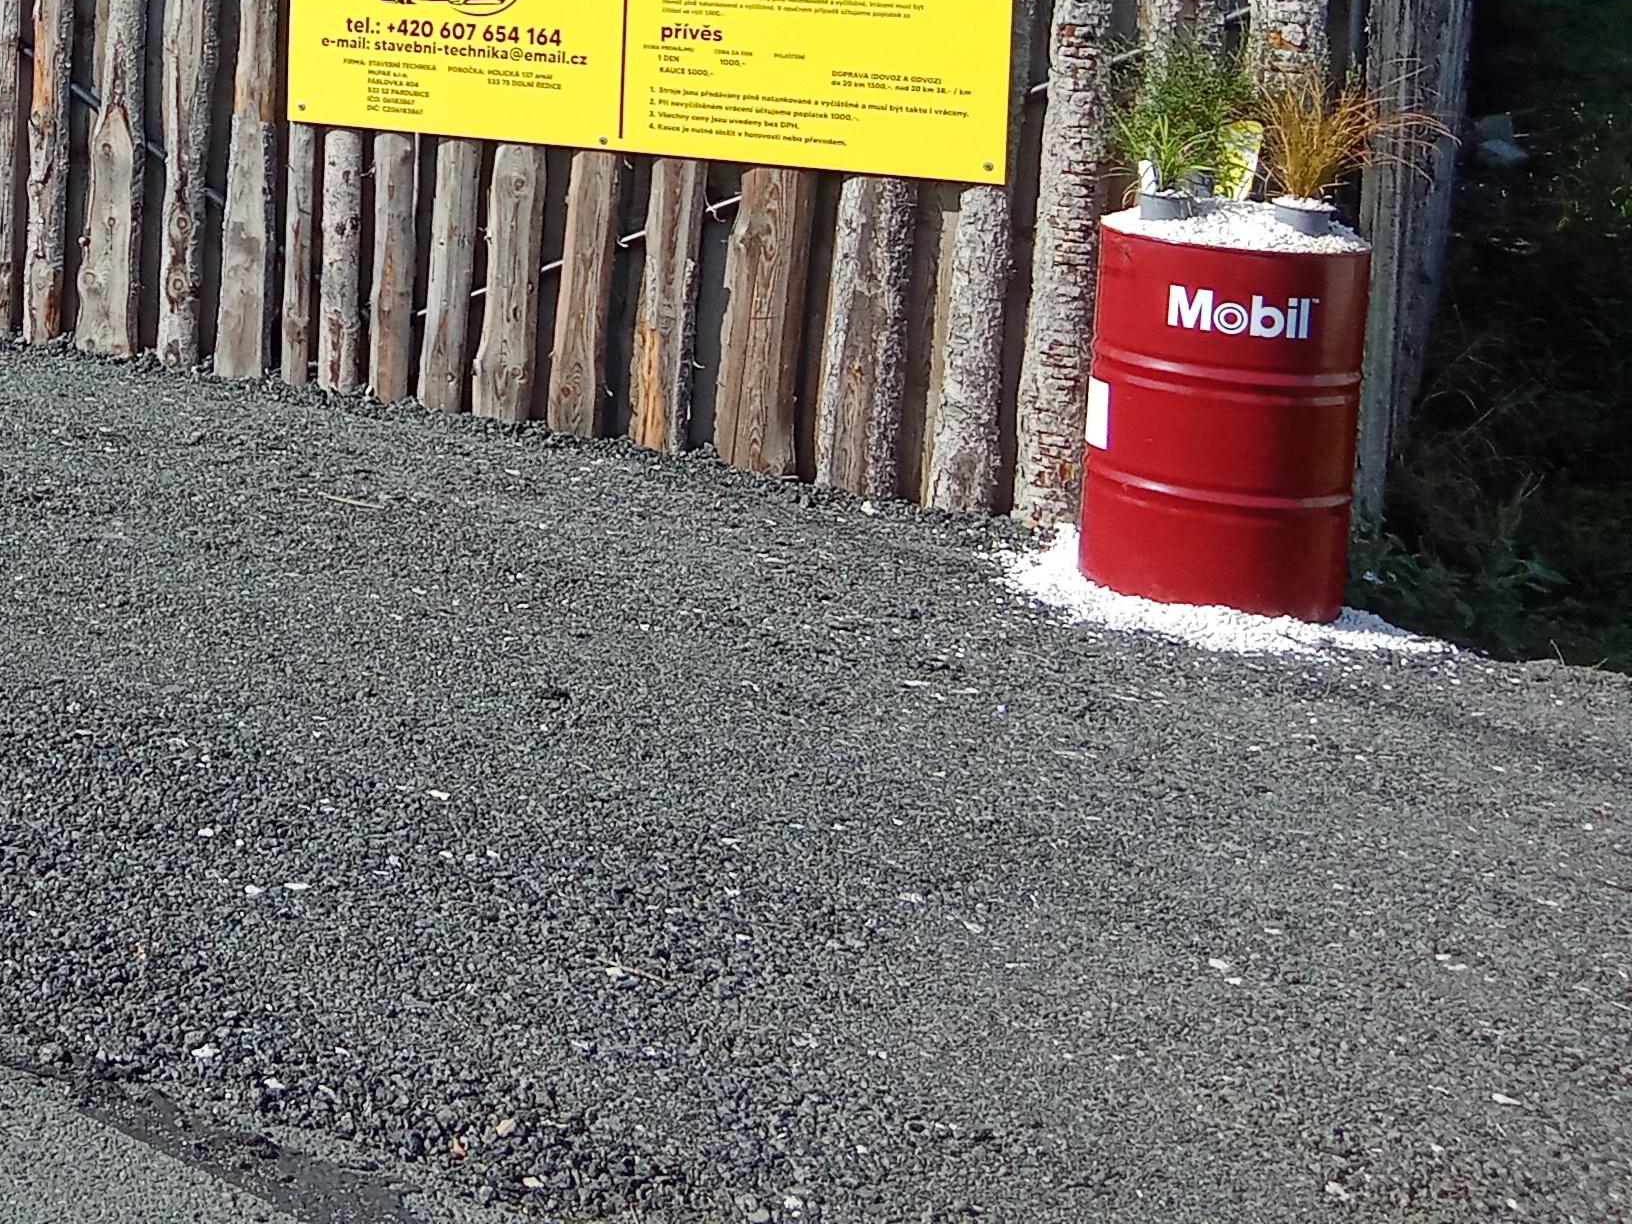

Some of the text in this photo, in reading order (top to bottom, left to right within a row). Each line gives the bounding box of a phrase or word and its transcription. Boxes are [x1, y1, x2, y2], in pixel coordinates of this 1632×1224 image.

[346, 17, 562, 47] tel.: +420 607 654 164
[661, 23, 723, 42] přívěs
[321, 36, 370, 50] e-mail:
[663, 54, 680, 62] DEN
[659, 66, 685, 75] KAUCE
[1167, 284, 1311, 339] Mobil
